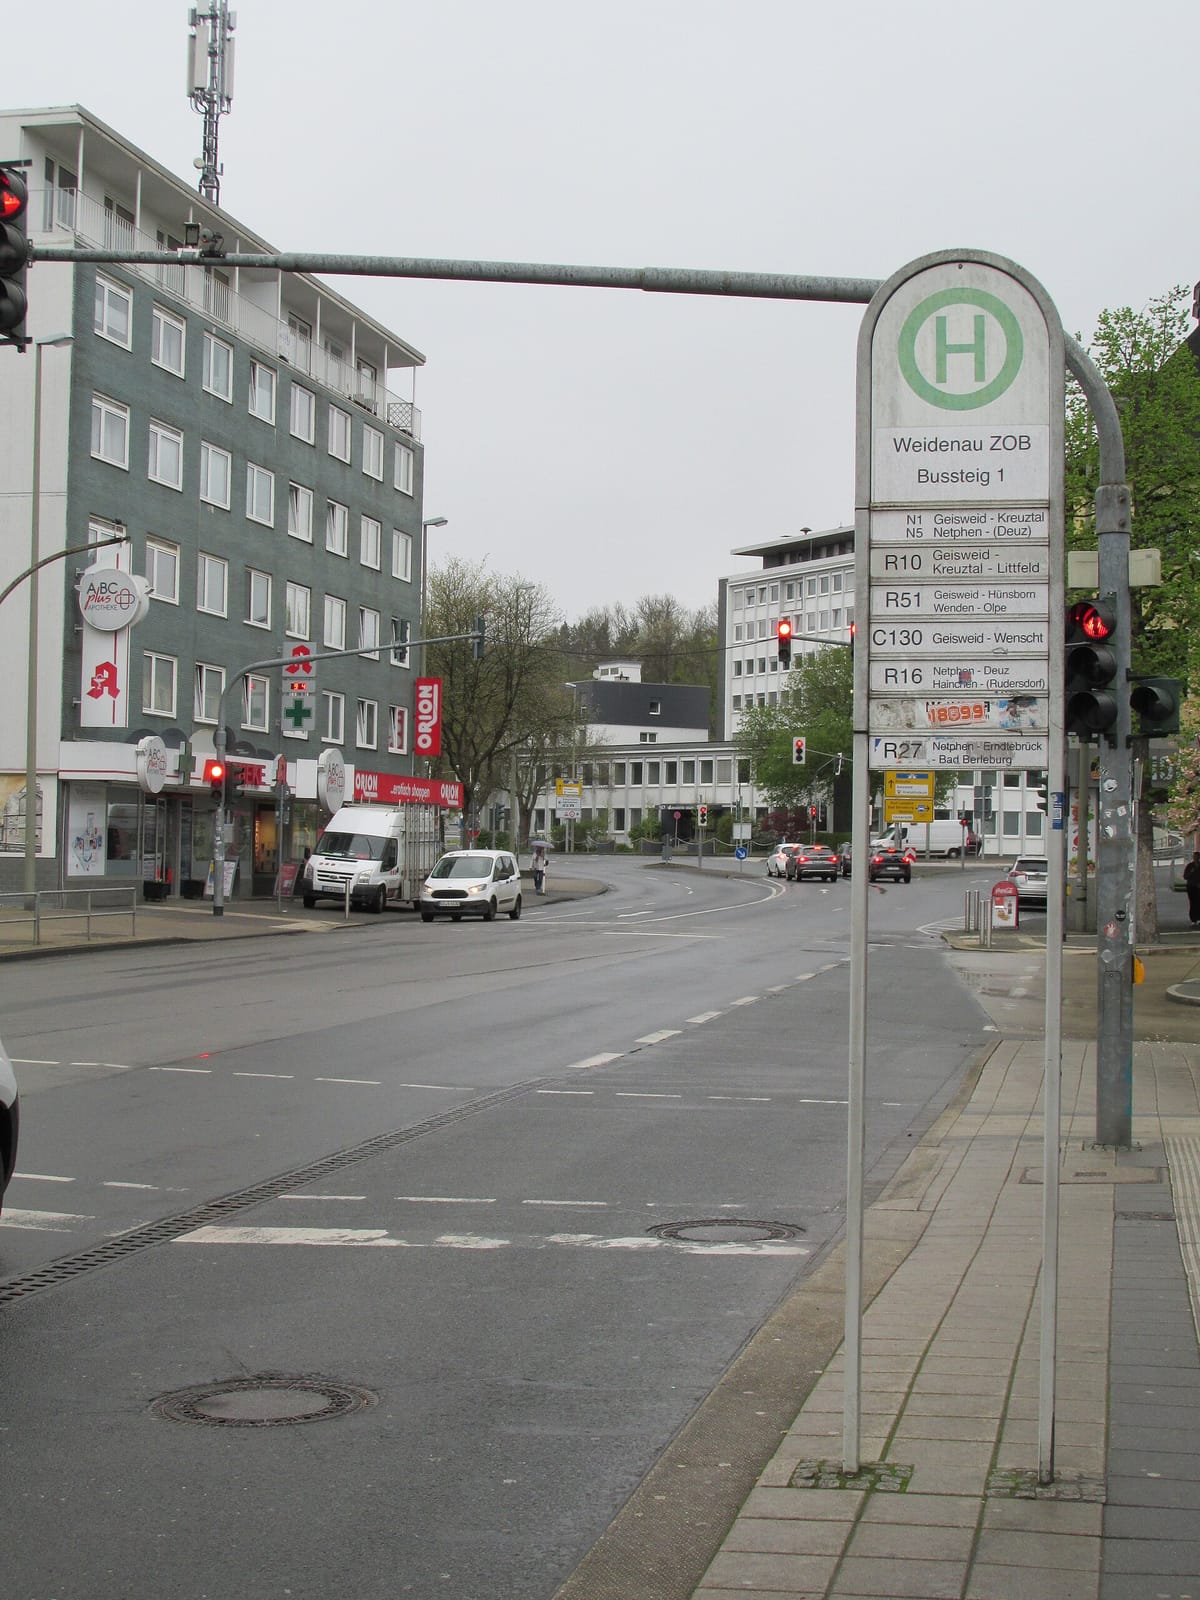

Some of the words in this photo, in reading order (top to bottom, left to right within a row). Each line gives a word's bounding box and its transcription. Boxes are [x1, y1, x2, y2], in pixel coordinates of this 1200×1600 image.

[893, 436, 983, 453] Weidenau
[989, 434, 1032, 452] ZOB
[917, 468, 990, 486] Bussteig
[997, 468, 1005, 482] 1
[906, 514, 922, 526] N1
[933, 513, 987, 525] Geisweid
[997, 511, 1045, 524] Kreuztal
[906, 527, 924, 539] N5
[933, 526, 983, 541] Netphen
[993, 526, 1032, 540] (Deuz)
[884, 554, 922, 571] R10
[932, 549, 990, 561] Geisweid
[933, 563, 983, 575] Kreuztal
[997, 562, 1040, 574] Littfeld
[86, 582, 118, 594] ABC
[934, 590, 979, 600] Geisweid
[988, 589, 1036, 600] Hünsborn
[84, 586, 111, 611] plus
[885, 591, 921, 608] R51
[933, 603, 974, 613] Wenden
[983, 602, 1007, 615] Olpe
[872, 629, 923, 646] C130
[932, 632, 984, 644] Geisweid
[993, 632, 1044, 644] Wenscht
[884, 668, 923, 684] R16
[984, 665, 1010, 675] Deuz
[986, 678, 1045, 690] (Rudersdorf)
[417, 683, 439, 749] ORION
[884, 742, 922, 759] R27
[932, 741, 974, 753] Netphen
[983, 741, 1042, 752] Erndtebrück
[938, 754, 960, 765] Bad
[962, 754, 1013, 766] Berleburg
[355, 773, 379, 798] ORION
[440, 783, 459, 806] ORION
